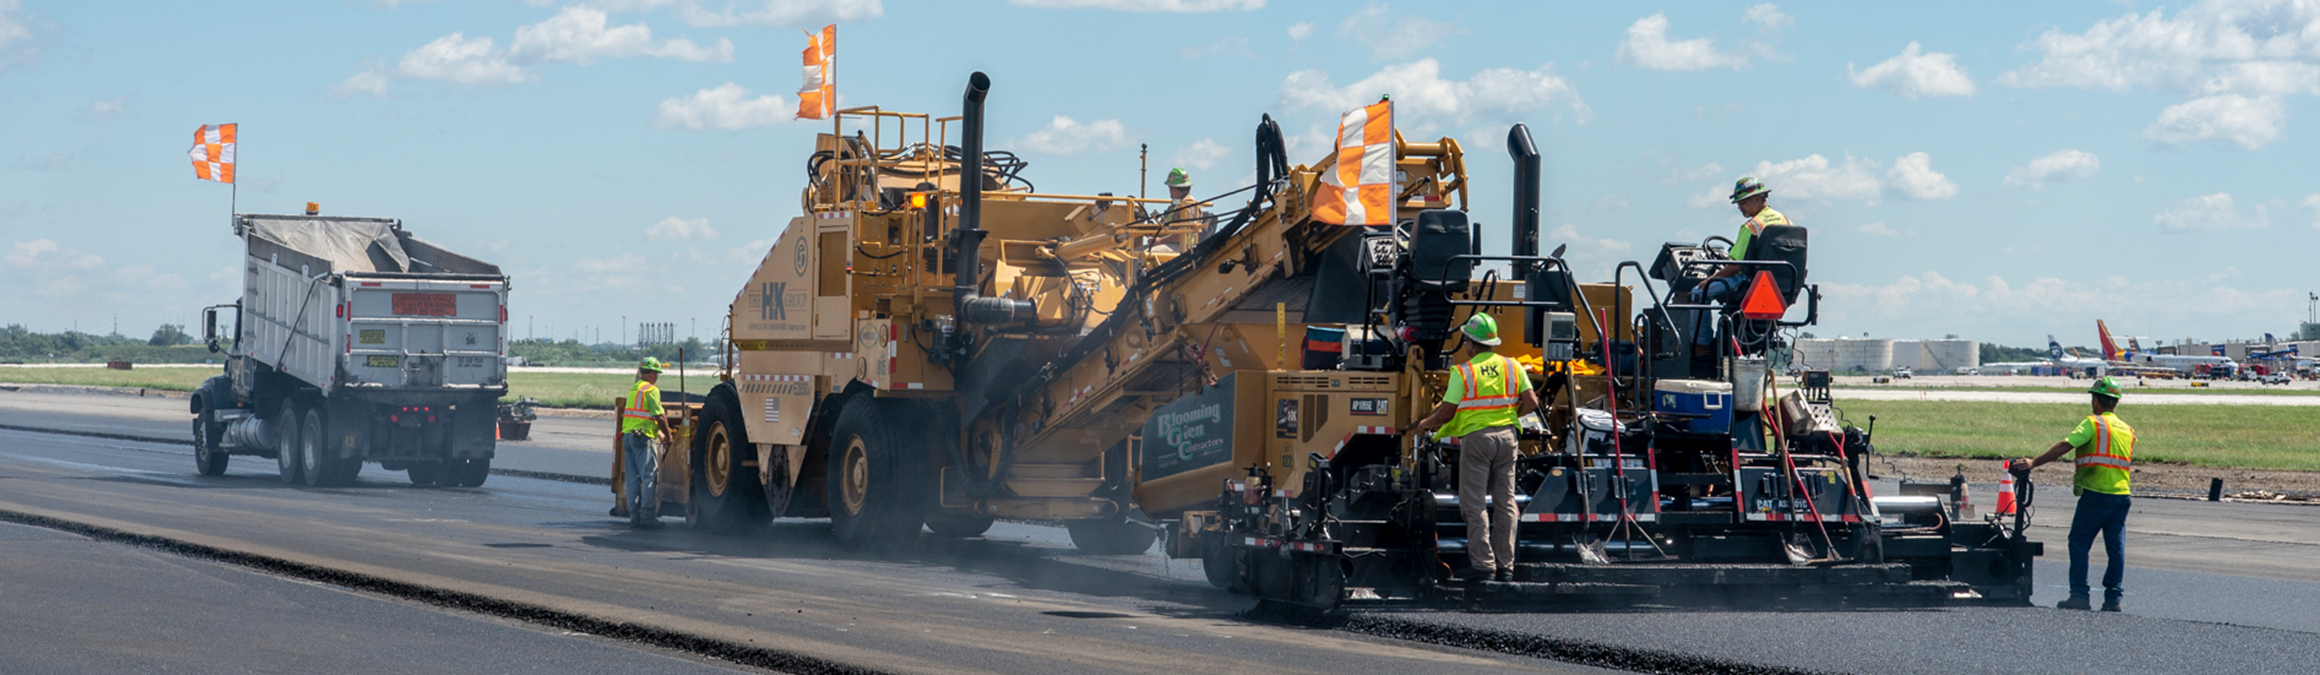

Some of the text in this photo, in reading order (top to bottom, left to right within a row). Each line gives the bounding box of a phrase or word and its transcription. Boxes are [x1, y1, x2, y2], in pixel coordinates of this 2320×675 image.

[748, 294, 761, 308] THE
[785, 293, 807, 308] GROUP
[466, 336, 475, 345] 56
[1376, 399, 1388, 414] CAT
[1157, 403, 1221, 438] Blooming
[1167, 424, 1205, 447] Glen
[1178, 438, 1224, 460] Contractors
[1756, 499, 1773, 511] CAT
